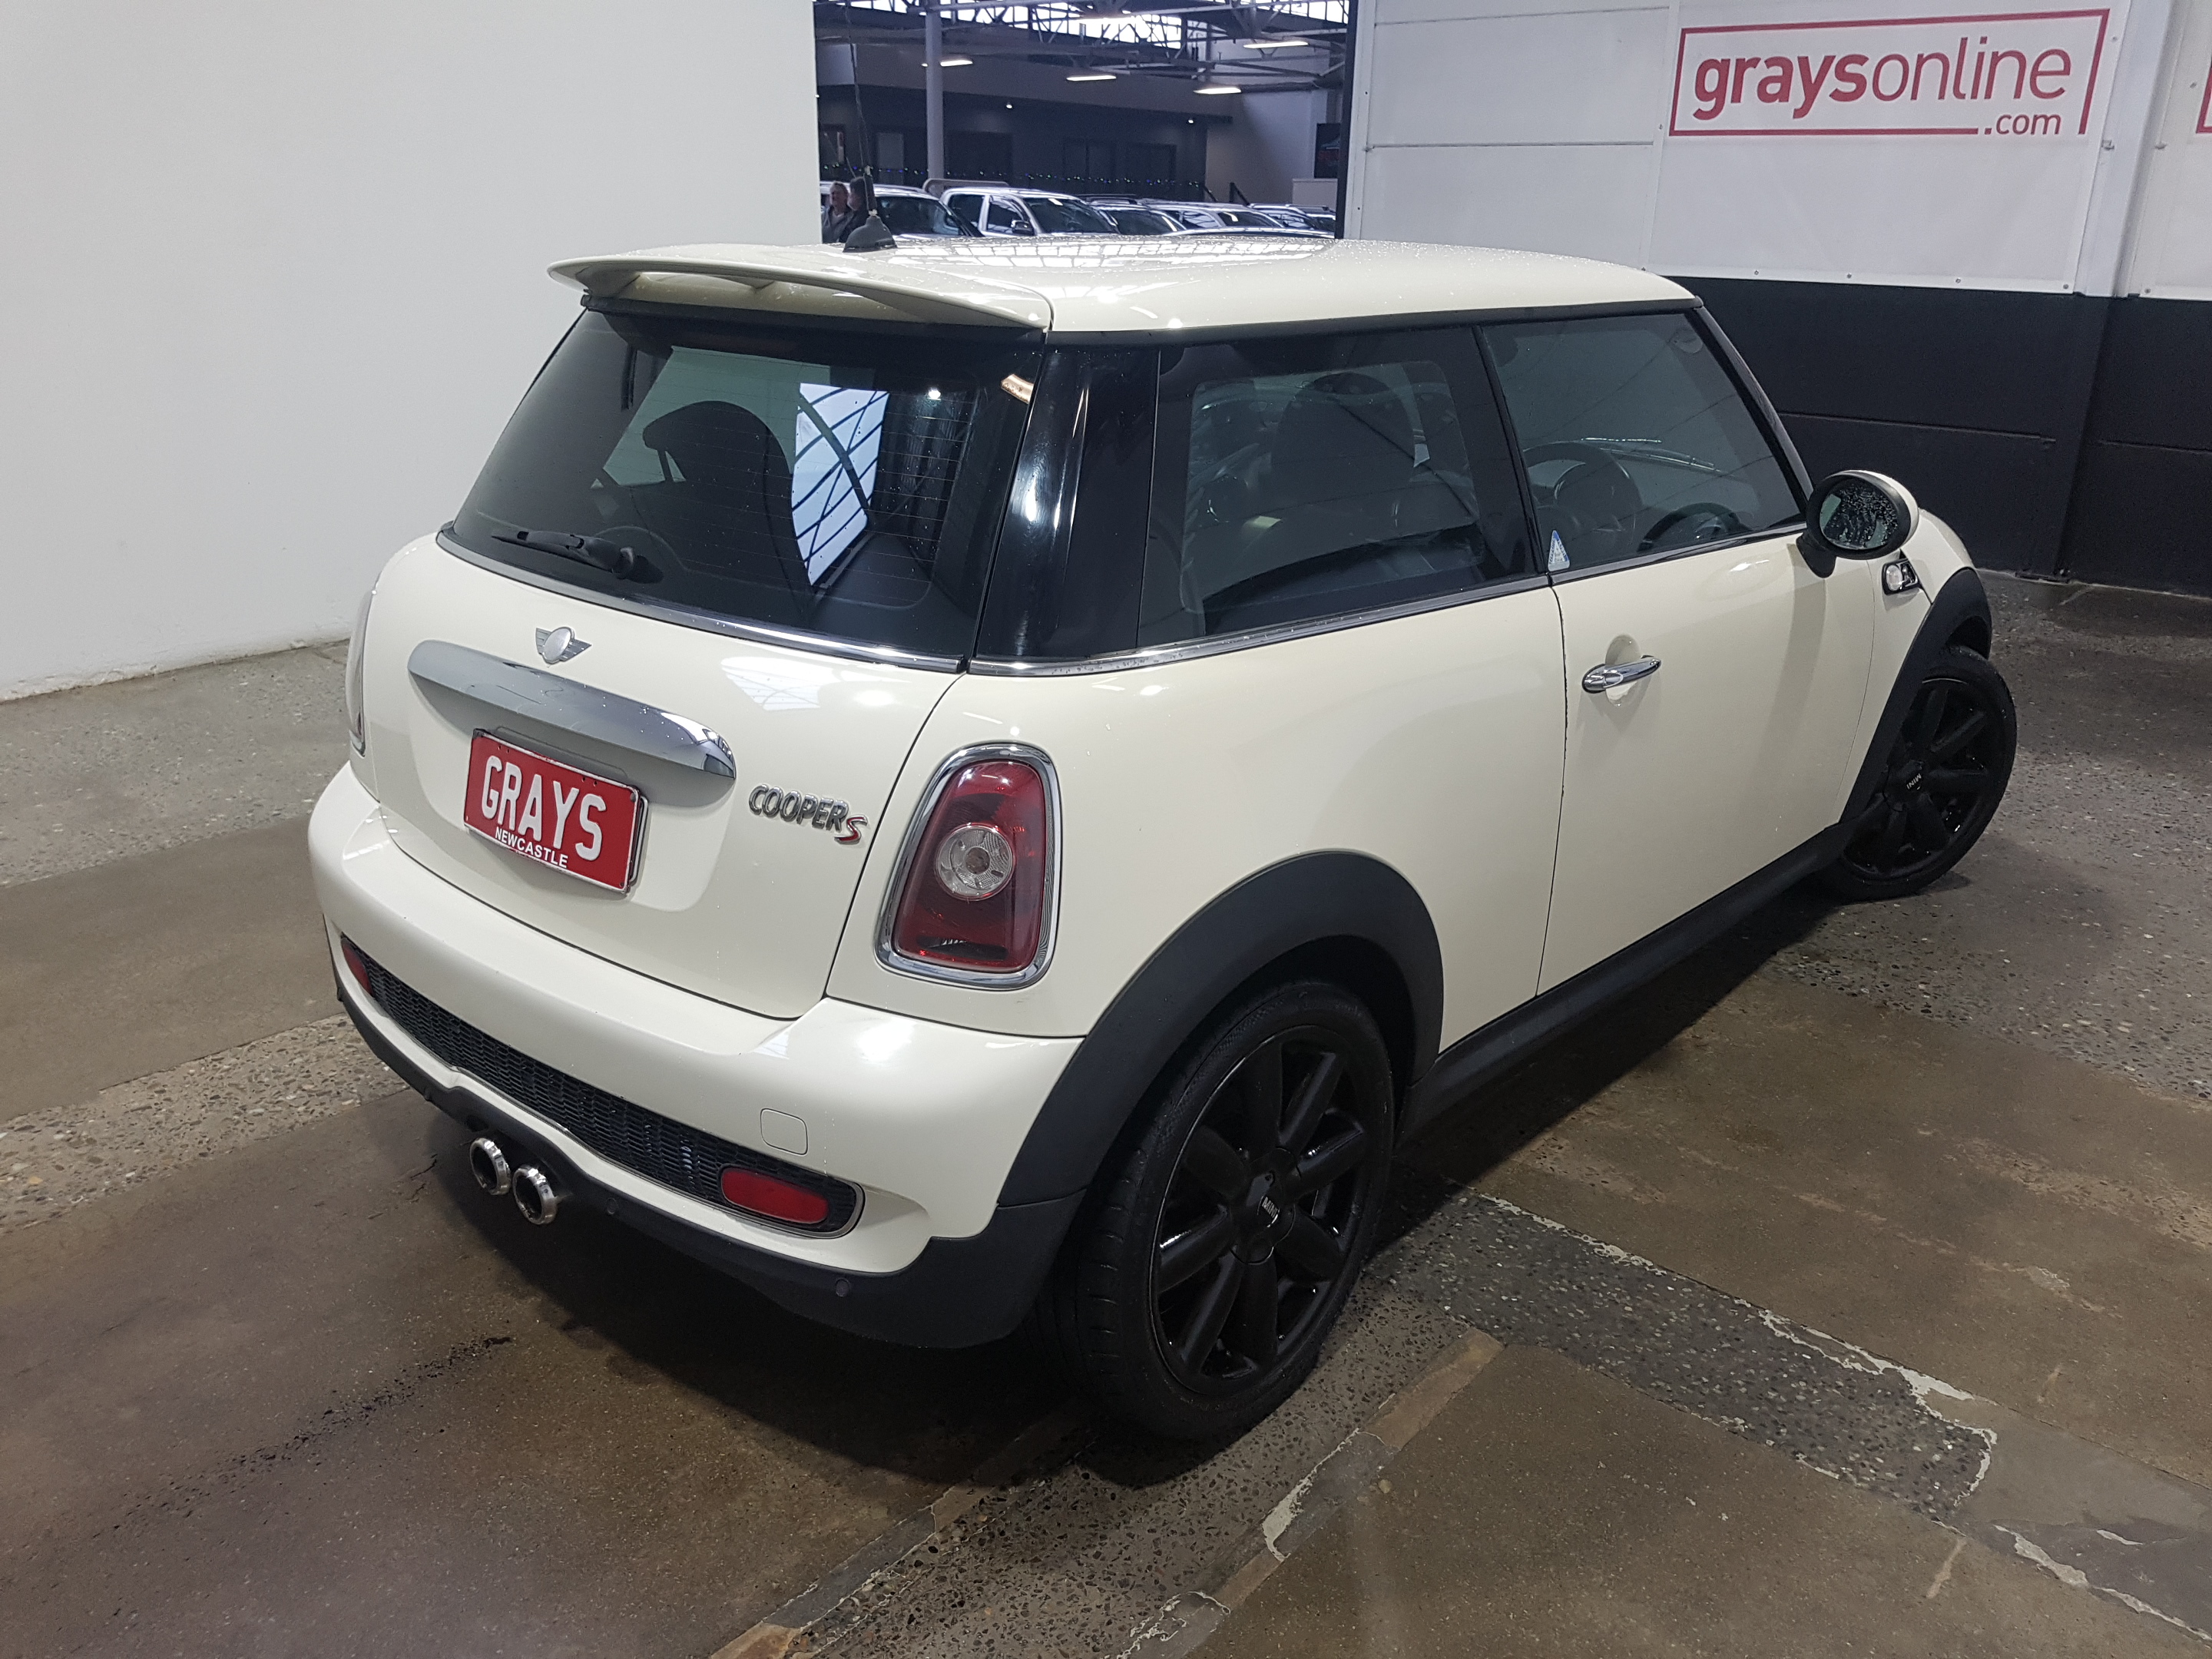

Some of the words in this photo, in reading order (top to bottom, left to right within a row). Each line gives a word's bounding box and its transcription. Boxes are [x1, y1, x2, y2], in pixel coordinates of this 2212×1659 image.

[1693, 36, 2071, 121] graysonline
[1983, 114, 2062, 135] .com
[1906, 773, 1922, 789] MINI
[482, 755, 607, 861] GRAYS
[495, 826, 568, 869] NEWCASTLE
[1261, 1197, 1278, 1218] MINI
